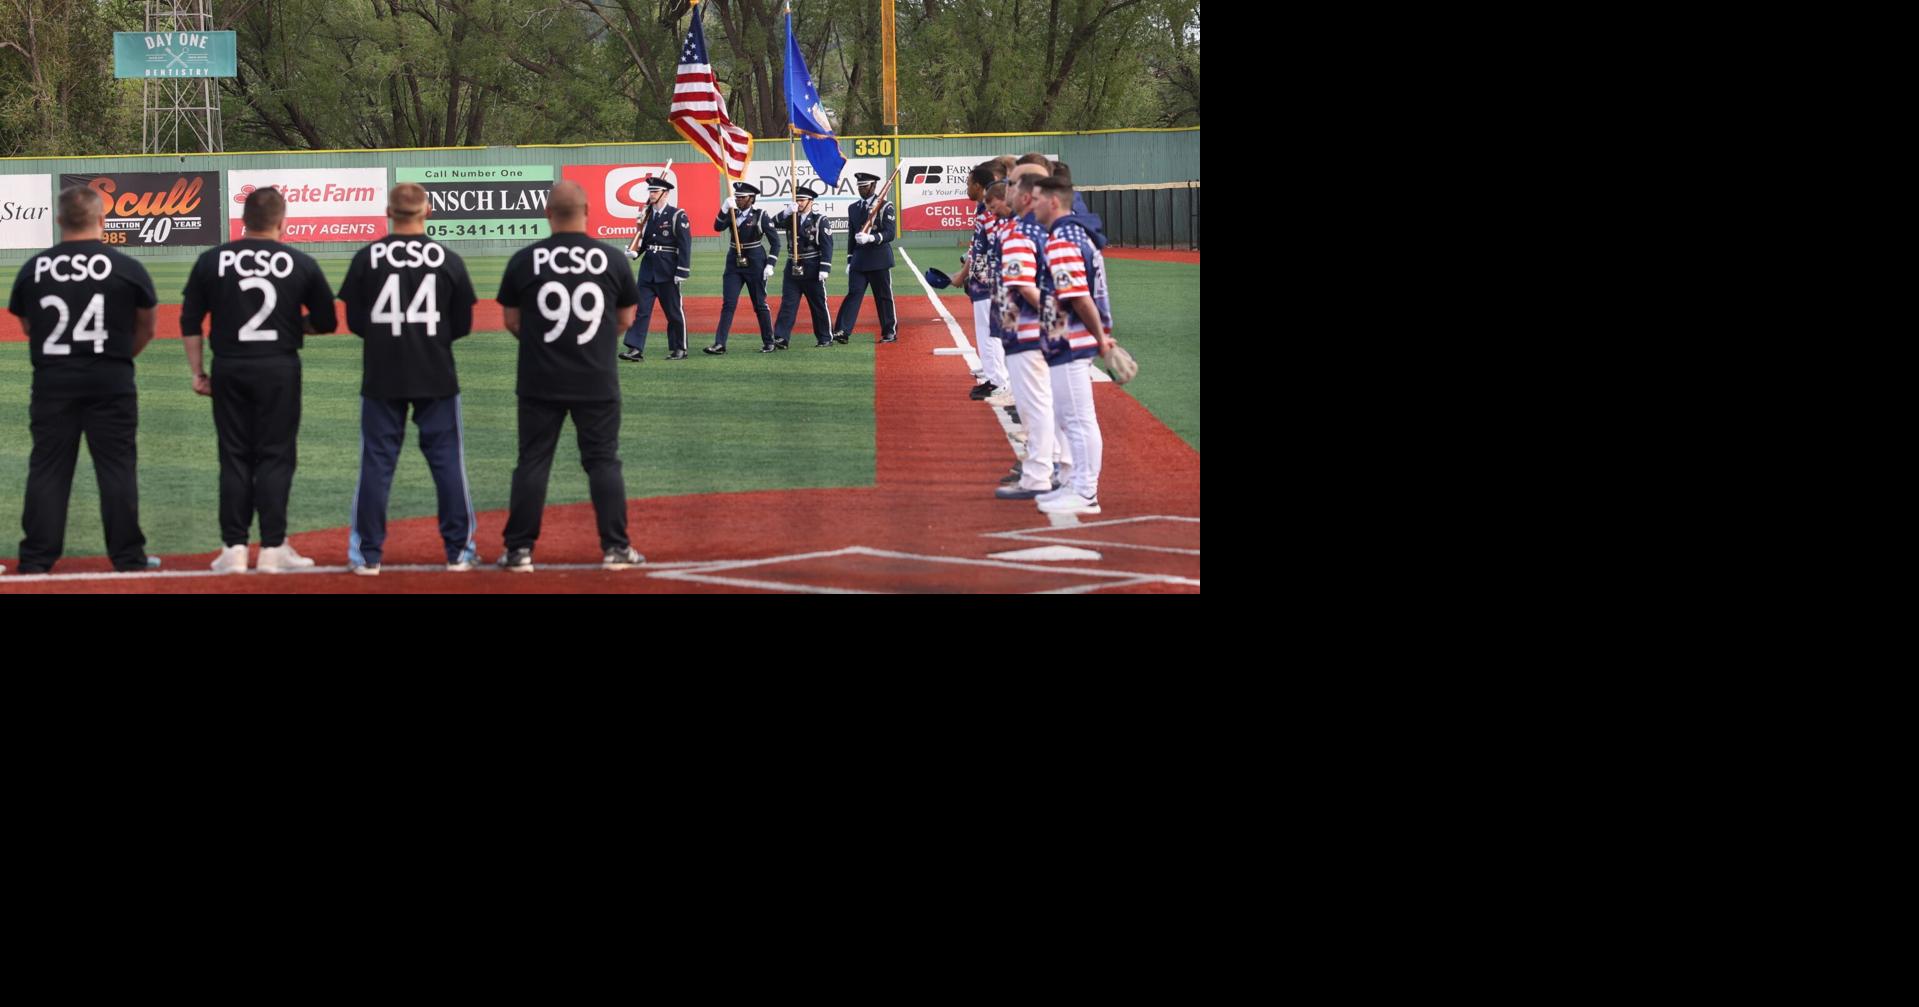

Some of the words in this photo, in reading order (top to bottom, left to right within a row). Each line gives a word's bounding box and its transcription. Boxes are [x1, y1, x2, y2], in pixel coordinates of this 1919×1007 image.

[144, 33, 172, 50] DAY
[180, 32, 208, 49] ONE
[145, 68, 208, 76] DENTISTRY
[855, 139, 891, 156] 330
[424, 170, 447, 178] Call
[452, 169, 496, 177] Number
[500, 169, 523, 177] One
[88, 176, 204, 217] Scull
[424, 190, 494, 212] NSCH
[499, 190, 550, 210] LAW
[1, 201, 48, 220] Star
[925, 206, 962, 216] CECIL
[138, 217, 172, 243] 40
[286, 225, 317, 235] CITY
[320, 224, 375, 235] AGENTS
[426, 224, 539, 236] 05-341-1111
[597, 225, 638, 236] Comm
[829, 218, 849, 229] ation
[102, 232, 127, 243] 985
[218, 249, 294, 279] PCSO
[370, 241, 446, 270] PCSO
[533, 246, 608, 275] PCSO
[34, 254, 113, 283] PCSO
[237, 277, 279, 341] 2
[370, 273, 441, 337] 44
[536, 281, 605, 346] 99
[39, 293, 109, 355] 24
